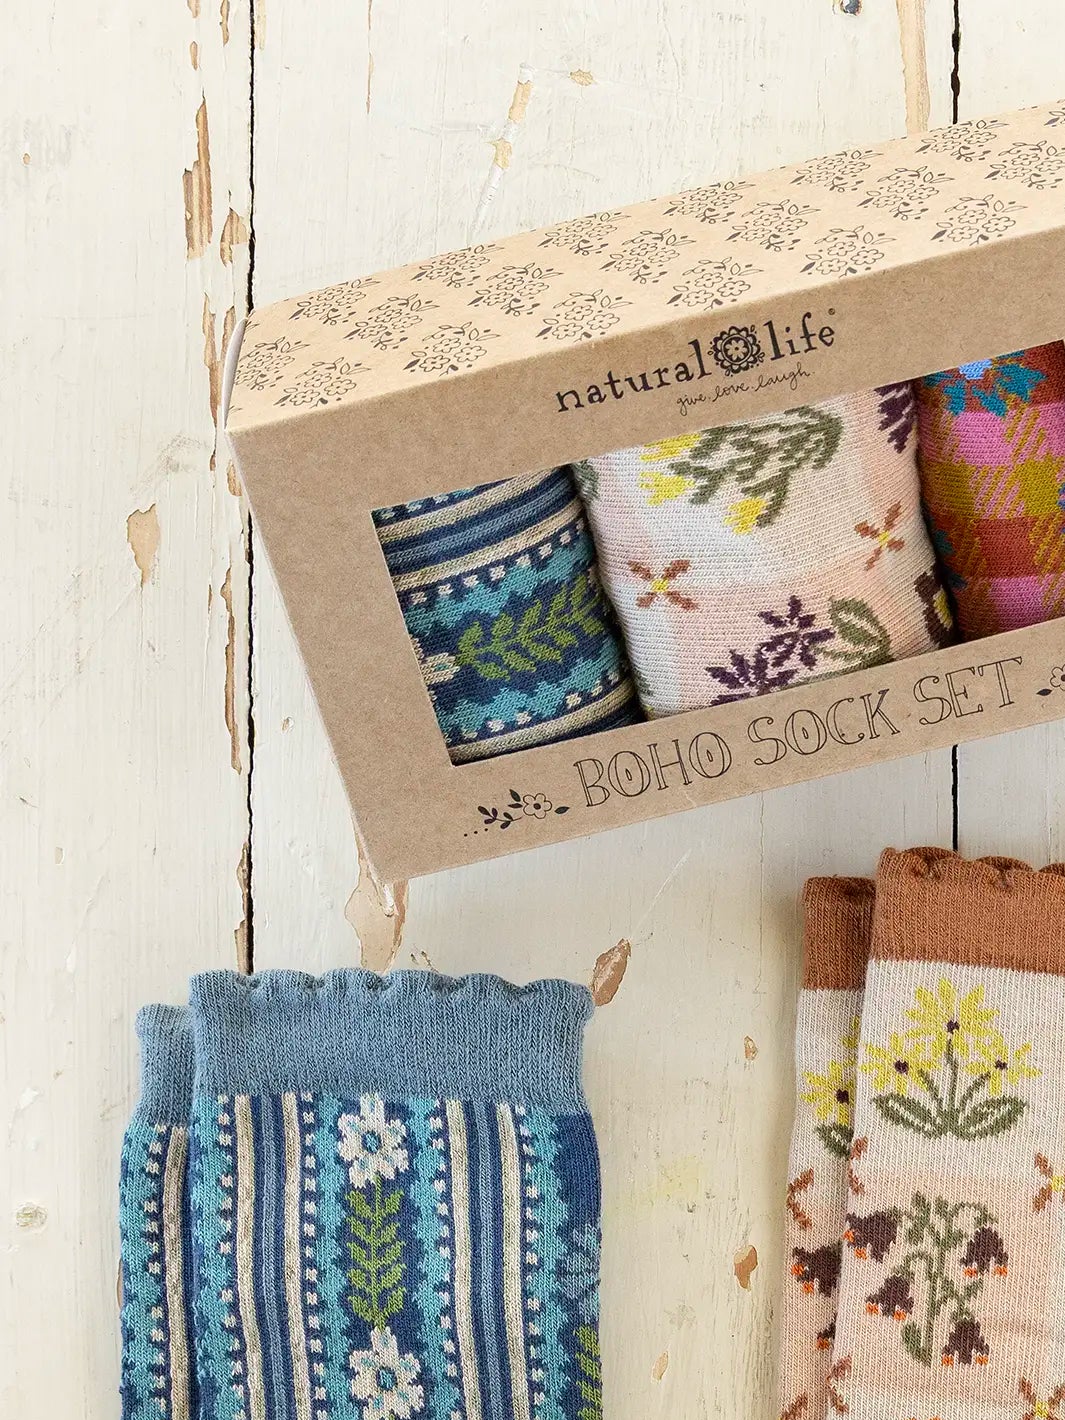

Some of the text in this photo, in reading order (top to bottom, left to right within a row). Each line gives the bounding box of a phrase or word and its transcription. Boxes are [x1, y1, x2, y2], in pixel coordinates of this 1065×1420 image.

[555, 339, 712, 412] natural
[573, 656, 1022, 808] BOHO SOCK SET
